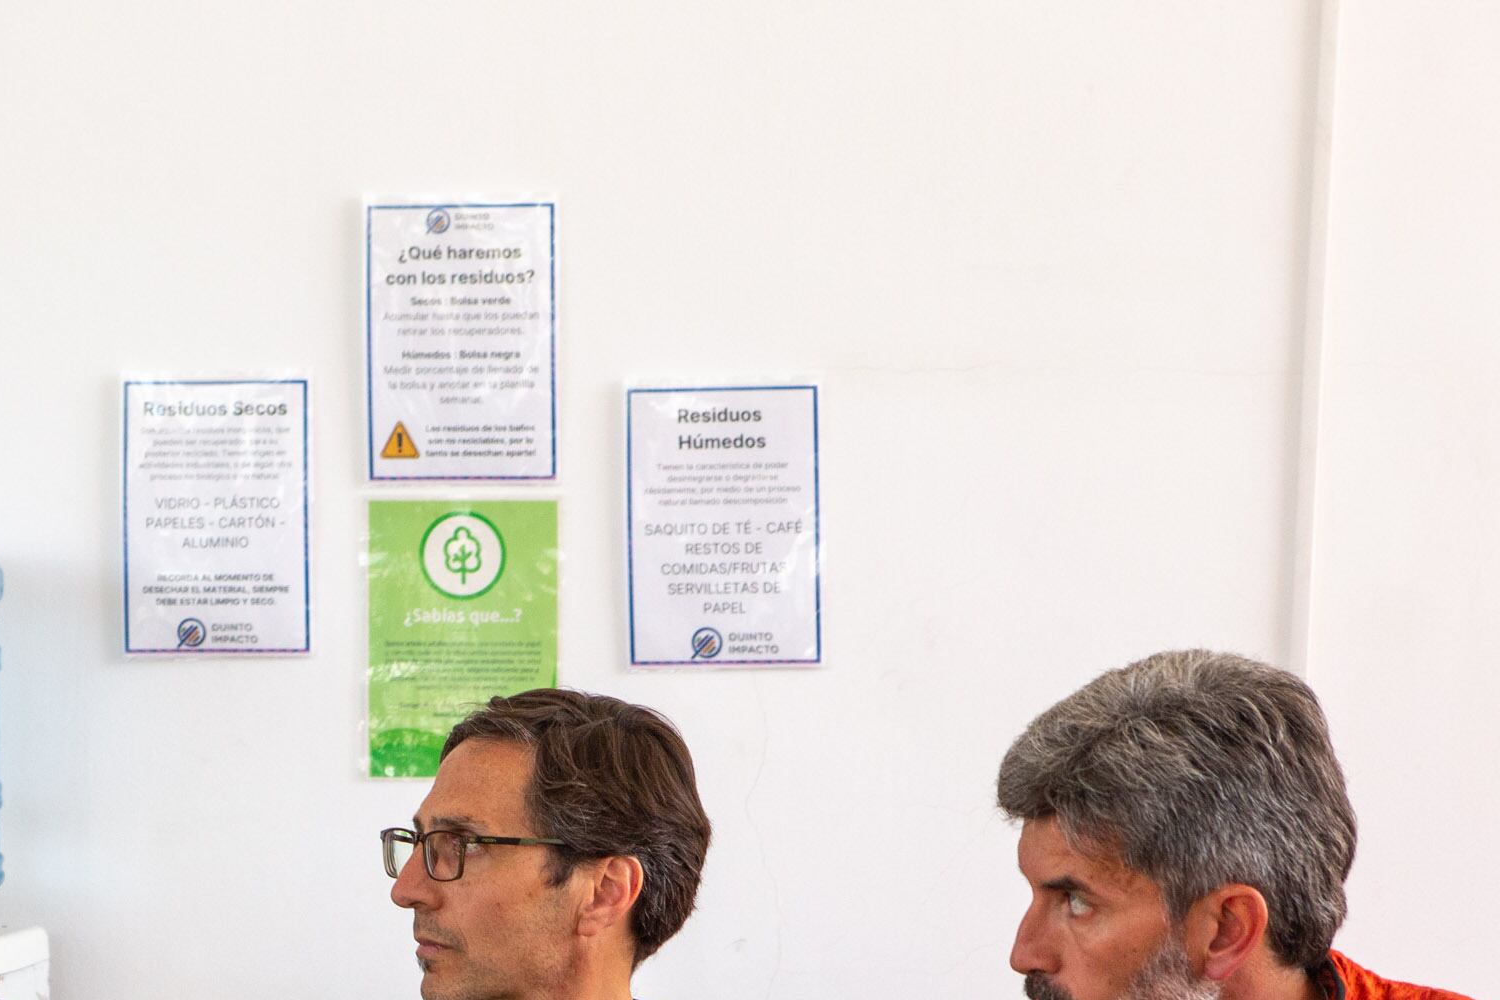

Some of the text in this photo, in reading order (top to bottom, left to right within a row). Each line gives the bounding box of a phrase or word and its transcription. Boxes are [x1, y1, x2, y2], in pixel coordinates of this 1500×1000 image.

[398, 245, 522, 263] ¿Qué haremos
[386, 269, 535, 285] con los residuos?
[410, 296, 511, 306] Secos Bolsa verde
[382, 311, 429, 321] Acumular
[462, 313, 481, 322] que
[484, 311, 498, 320] los
[501, 311, 540, 322] puedan
[397, 326, 525, 337] retirar los recuperadores.
[402, 349, 451, 360] Húmedos
[459, 349, 488, 359] Bolsa
[490, 351, 521, 361] negra
[383, 365, 412, 375] Medir
[471, 365, 485, 374] de
[399, 380, 427, 390] bolsa
[429, 382, 435, 391] y
[143, 401, 288, 417] Residuos Secos
[677, 407, 762, 423] Residuos
[481, 424, 491, 432] de
[678, 433, 766, 450] Húmedos
[657, 463, 684, 471] Tienen
[686, 462, 694, 471] la
[752, 461, 762, 469] de
[764, 461, 788, 471] poder
[700, 487, 714, 495] por
[768, 485, 802, 494] proceso
[155, 497, 200, 509] VIDRIO
[214, 494, 280, 509] PLÁSTICO
[146, 517, 204, 529] PAPELES
[218, 515, 276, 529] CARTÓN
[644, 522, 708, 537] SAQUITO
[712, 522, 730, 535] DE
[735, 519, 752, 534] TÉ
[766, 518, 803, 534] CAFÉ
[182, 536, 249, 548] ALUMINIO
[685, 542, 763, 555] RESTOS DE
[201, 574, 212, 582] AL
[214, 573, 260, 582] MOMENTO
[262, 573, 274, 581] DE
[142, 586, 189, 594] DESECHAR
[191, 586, 201, 594] EL
[252, 585, 290, 593] SIEMPRE
[668, 581, 781, 595] SERVILLETAS DE
[156, 598, 178, 606] DEBE
[179, 598, 208, 606] ESTAR
[209, 598, 240, 606] LIMPIO
[703, 602, 746, 614] PAPEL
[403, 608, 465, 628] ¿Sabías
[211, 623, 253, 633] QUINTO
[211, 635, 258, 644] IMPACTO
[728, 632, 773, 642] QUINTO
[728, 645, 779, 655] IMPACTO
